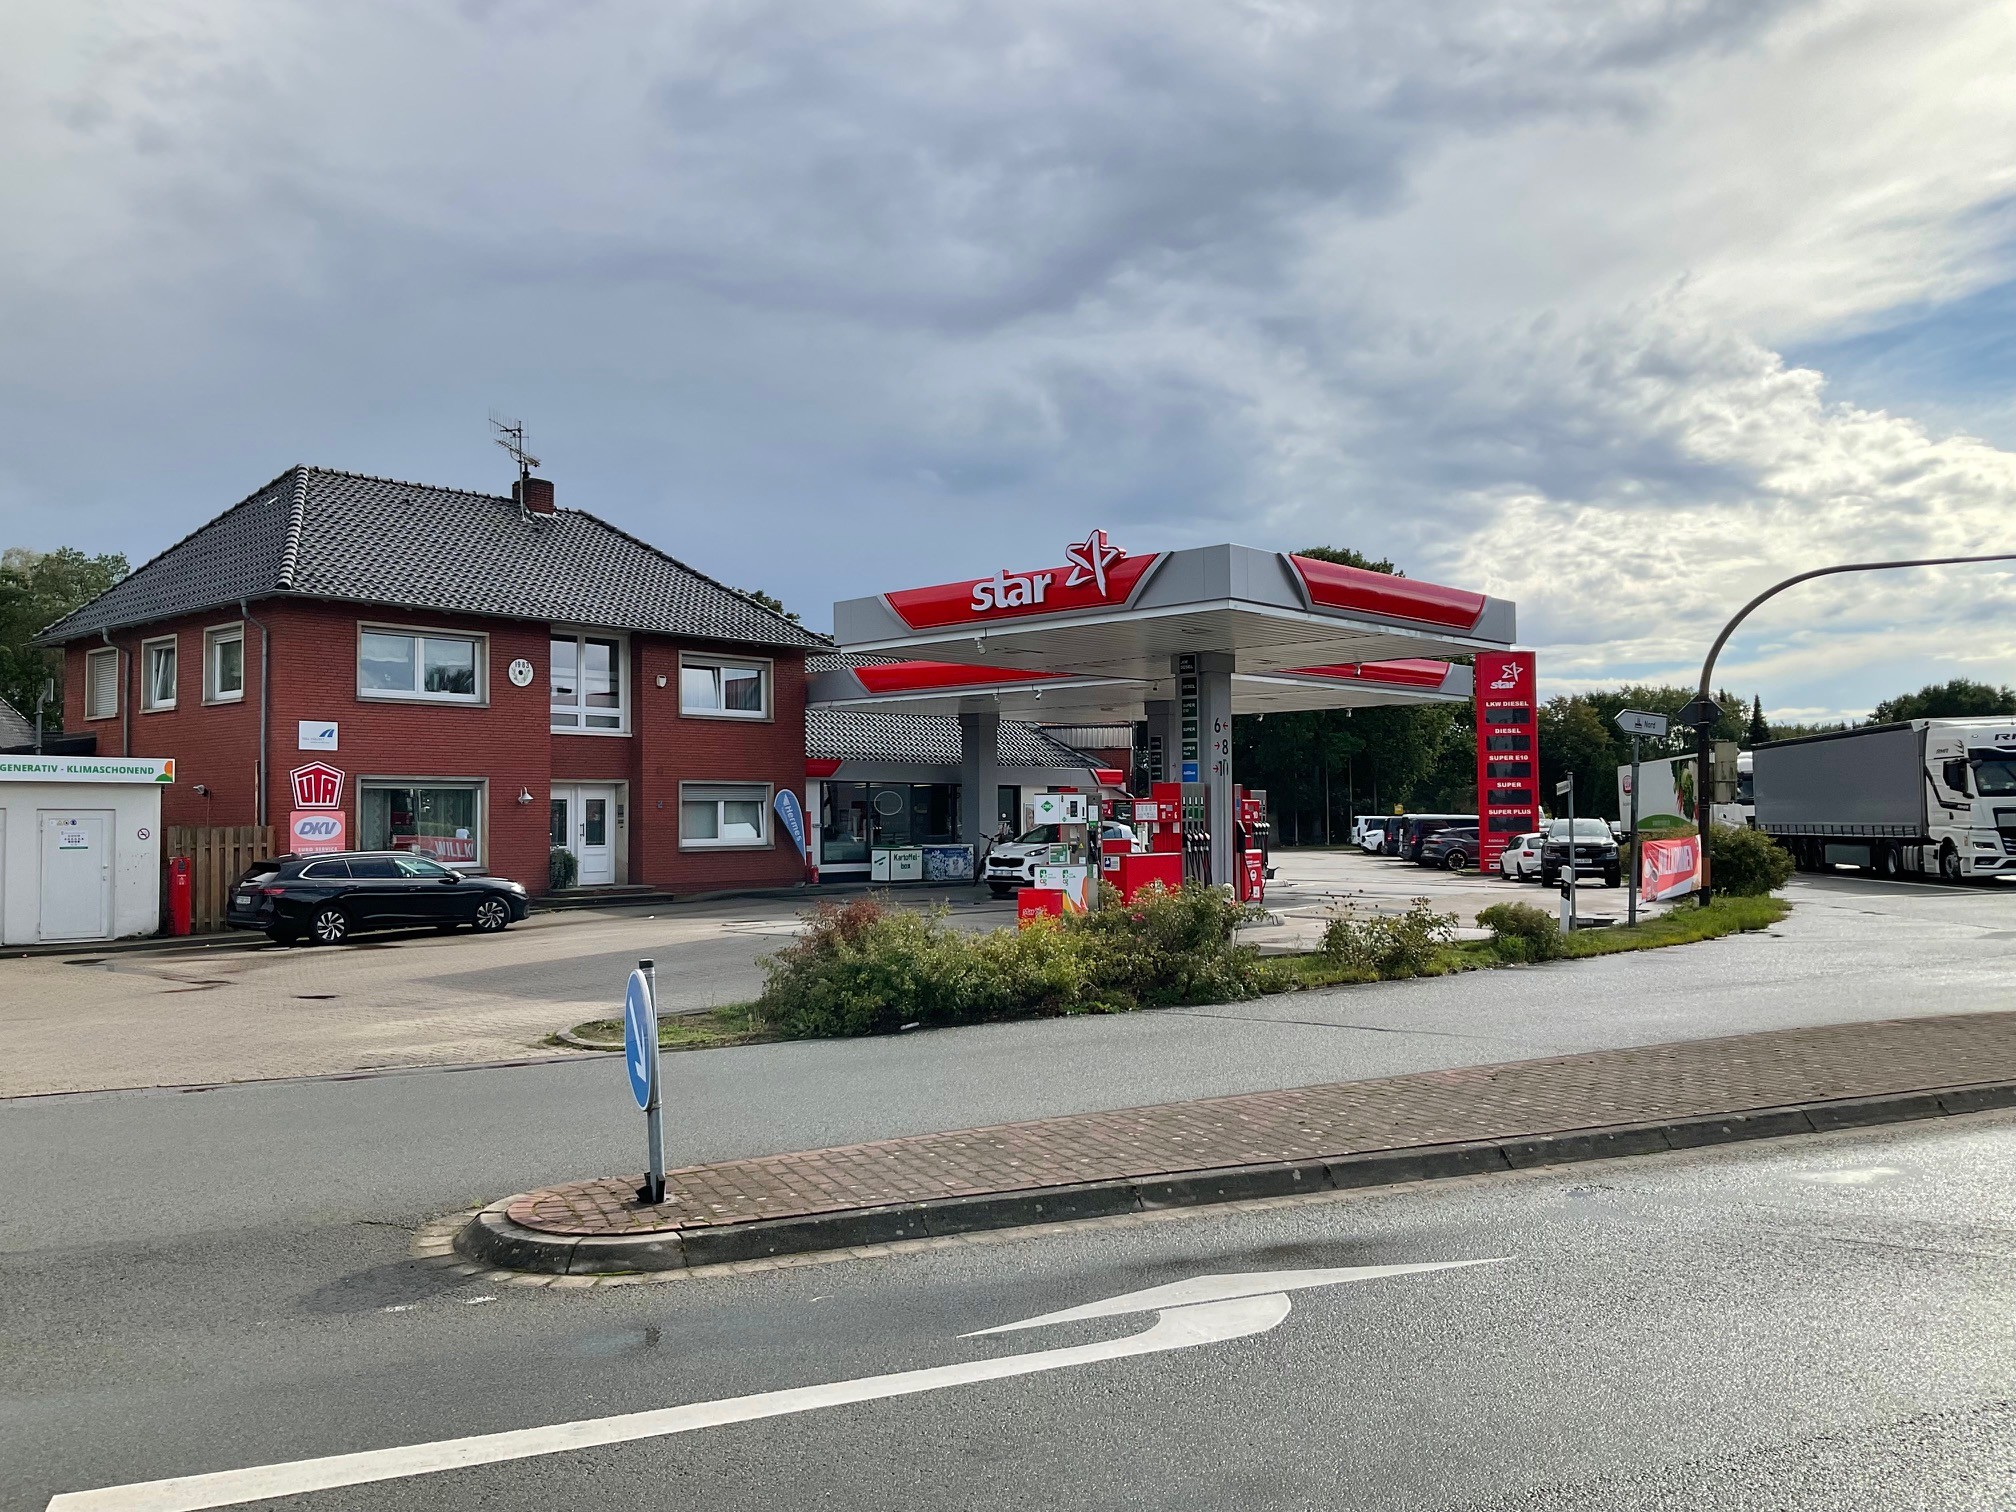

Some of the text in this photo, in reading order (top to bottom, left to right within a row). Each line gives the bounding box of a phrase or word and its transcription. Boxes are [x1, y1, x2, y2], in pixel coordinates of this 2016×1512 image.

[971, 569, 1052, 611] star
[514, 661, 530, 669] 1983
[1490, 680, 1516, 689] star
[1214, 718, 1221, 733] 6
[1644, 720, 1656, 729] Nord
[1222, 739, 1229, 755] 8
[0, 763, 58, 773] GENERATIV
[66, 765, 155, 775] KLIMASCHONEND
[297, 768, 339, 804] UTA
[298, 822, 338, 835] DKV
[785, 805, 803, 842] Hermes
[893, 853, 920, 861] Kartoffel-
[900, 862, 911, 870] box
